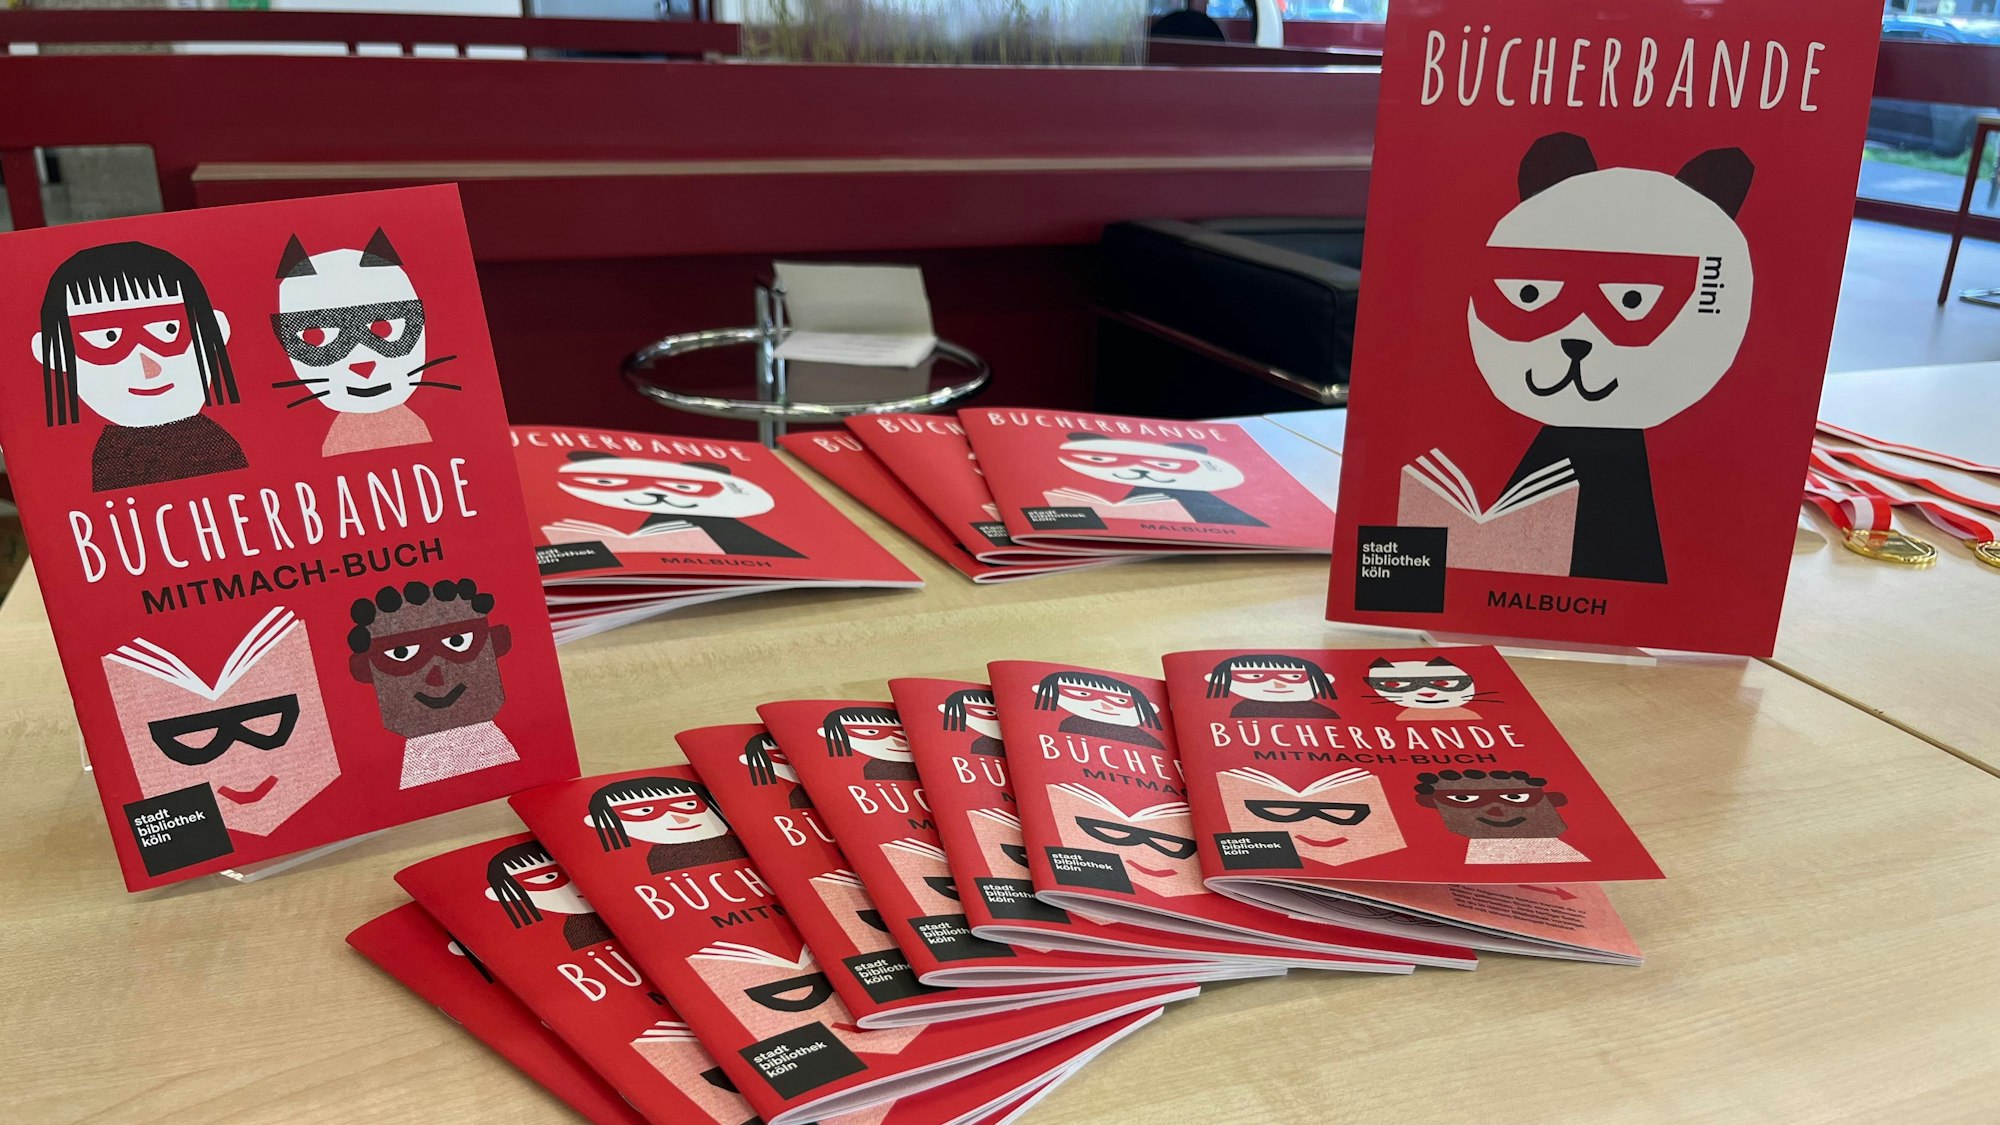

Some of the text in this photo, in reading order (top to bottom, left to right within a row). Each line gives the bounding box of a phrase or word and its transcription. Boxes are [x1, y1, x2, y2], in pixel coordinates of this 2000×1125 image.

[1420, 24, 1826, 112] BÜCHERBANDE
[1698, 256, 1725, 314] mini
[68, 457, 478, 583] BÜCHERBANDE
[1140, 523, 1236, 535] MALBUCH
[1362, 541, 1398, 553] stadt
[660, 557, 772, 568] MALBUCH
[1362, 553, 1431, 568] bibliothek
[141, 537, 445, 615] MITMACH-BUCH
[1361, 566, 1391, 579] köln
[1487, 590, 1608, 616] MALBUCH
[1209, 720, 1525, 750] BÜCHERBANDE
[1253, 750, 1497, 765] MITMACH-BUCH
[134, 808, 170, 826] stadt
[137, 810, 206, 837] bibliothek
[141, 832, 172, 848] köln
[1221, 842, 1281, 850] bibliothek
[1051, 853, 1083, 861] stadt
[1223, 848, 1250, 856] köln
[1053, 858, 1113, 870] bibliothek
[1055, 864, 1082, 872] köln
[919, 922, 952, 931] stadt
[927, 935, 956, 944] köln
[854, 959, 889, 971] stadt
[863, 973, 893, 985] köln
[753, 1044, 790, 1064] stadt
[759, 1041, 828, 1071] bibliothek
[766, 1062, 798, 1079] köln
